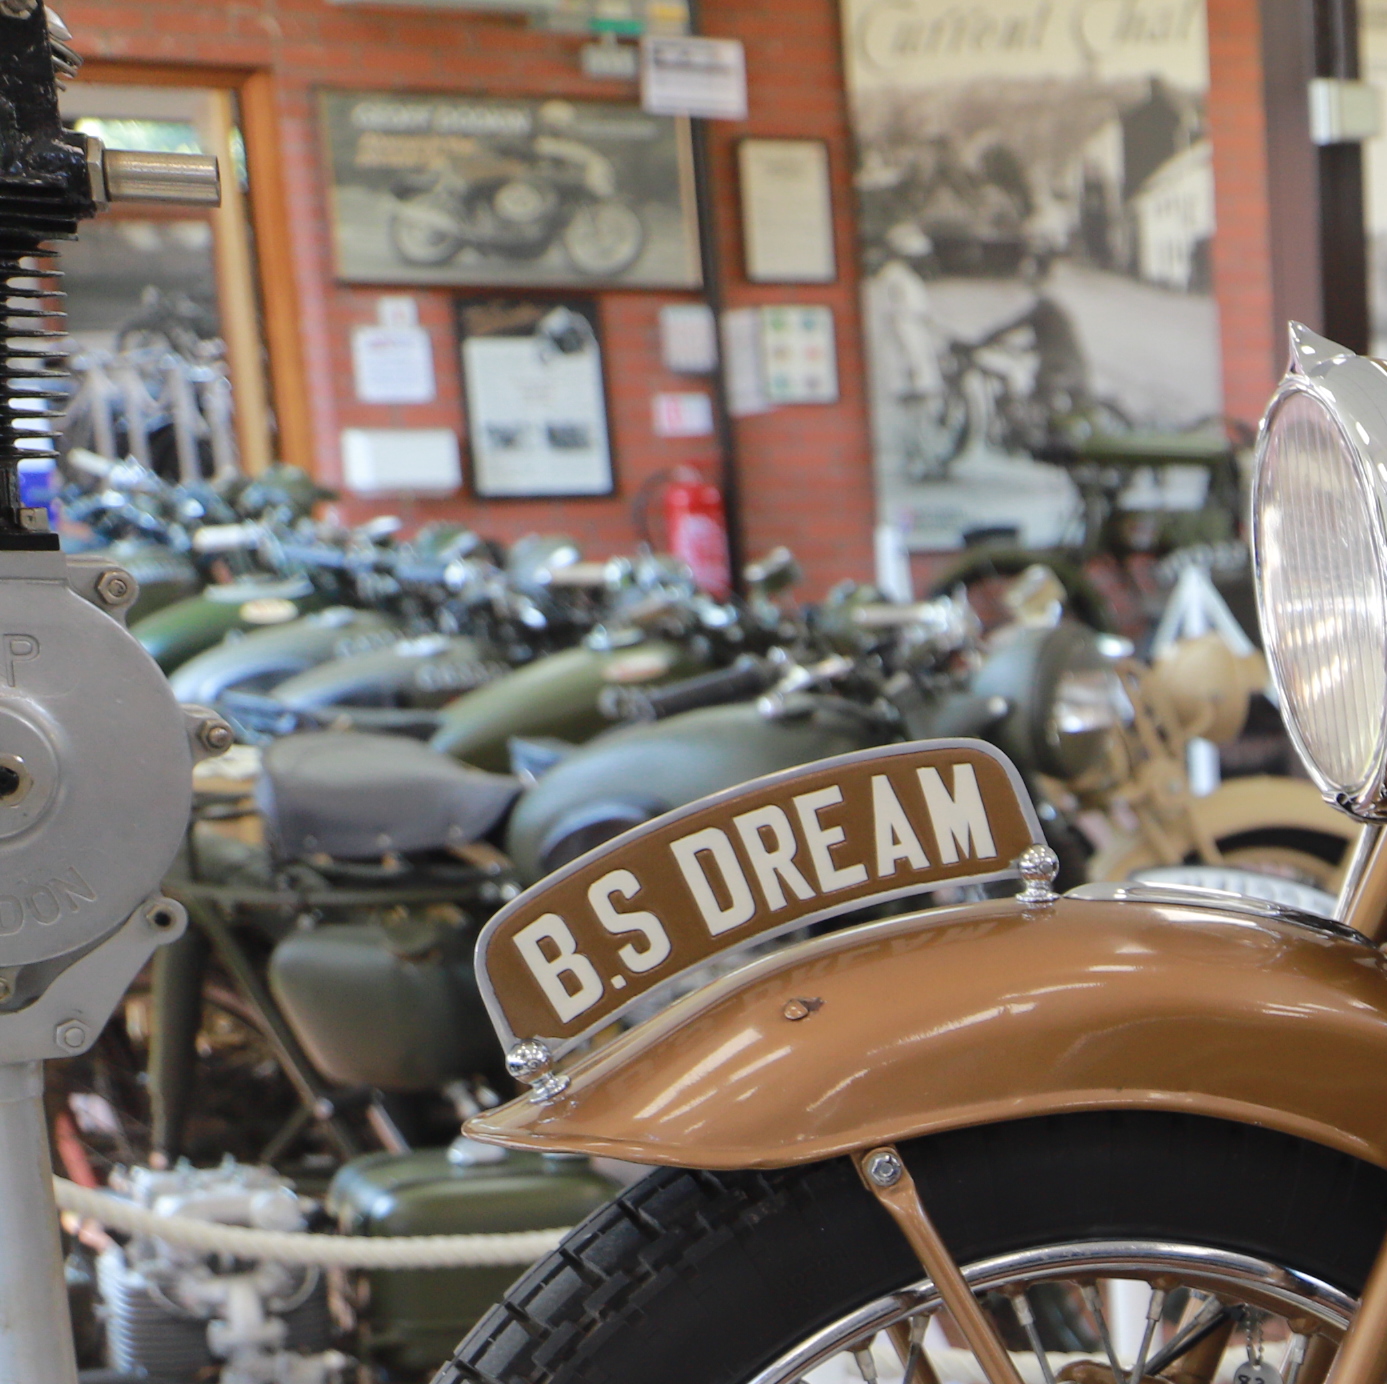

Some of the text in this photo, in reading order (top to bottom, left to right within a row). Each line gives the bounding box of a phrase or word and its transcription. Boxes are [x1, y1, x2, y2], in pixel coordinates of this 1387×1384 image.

[2, 632, 41, 688] P
[668, 762, 998, 937] DREAM
[0, 865, 97, 936] DON
